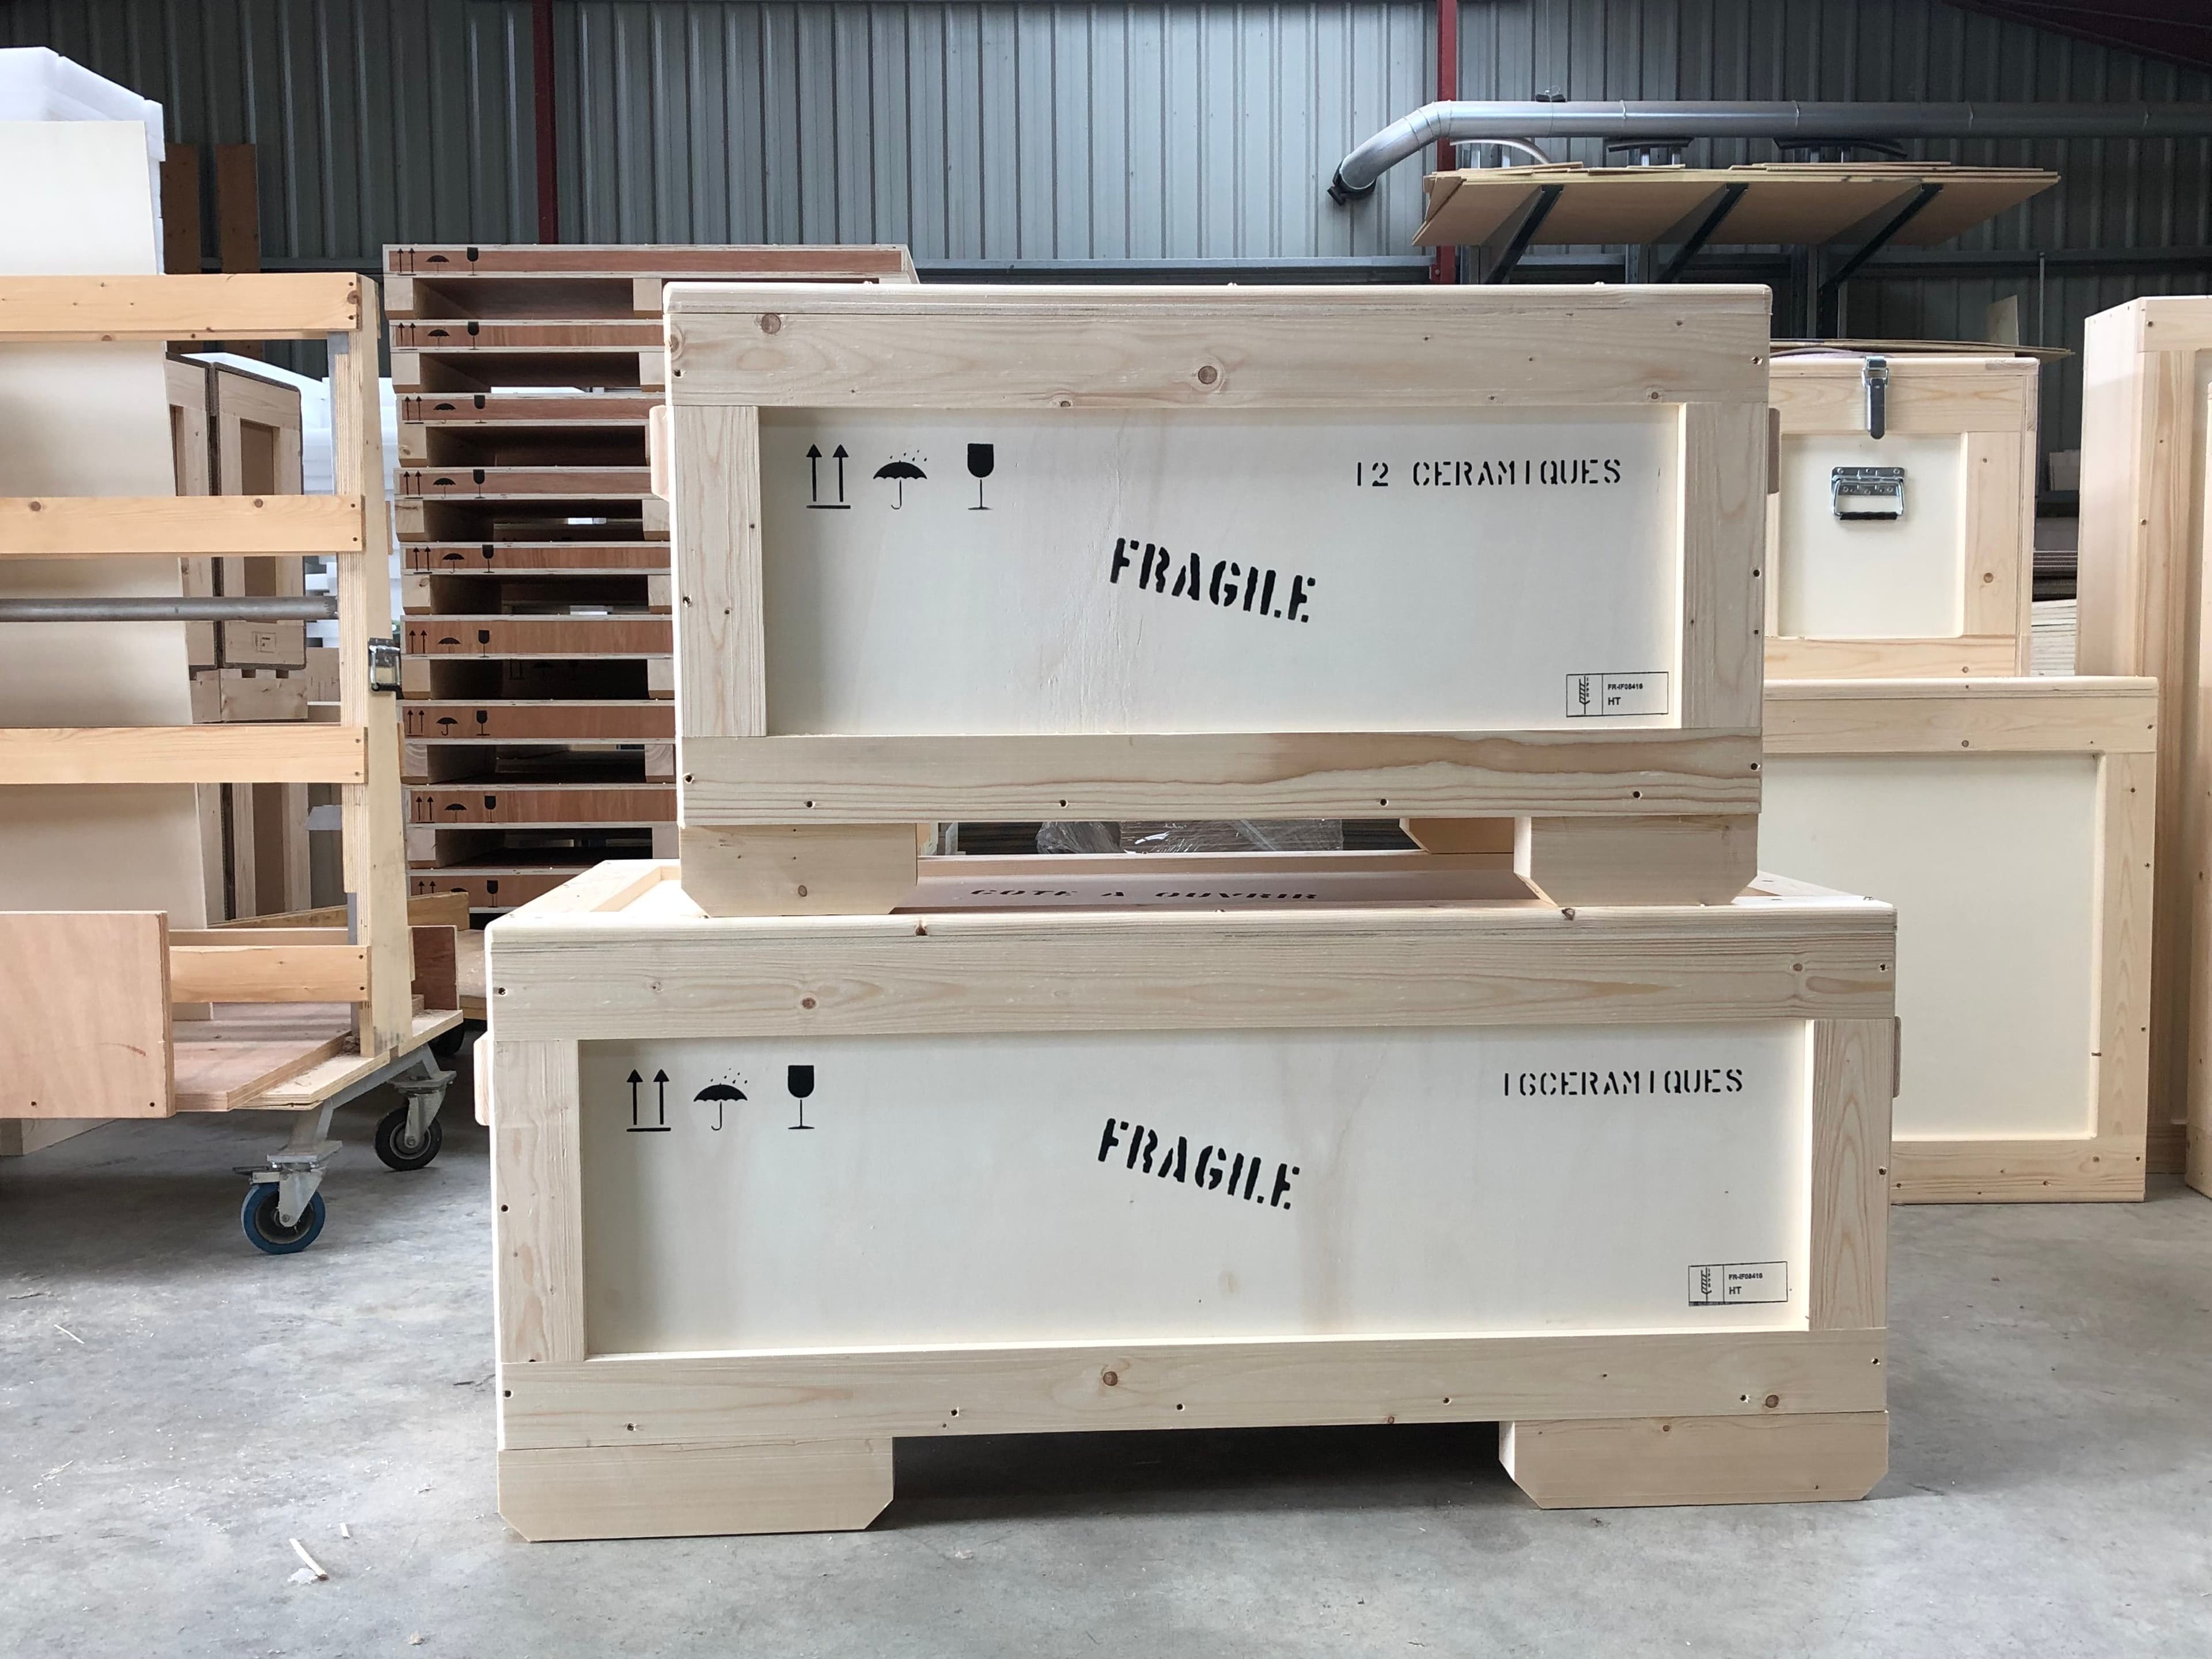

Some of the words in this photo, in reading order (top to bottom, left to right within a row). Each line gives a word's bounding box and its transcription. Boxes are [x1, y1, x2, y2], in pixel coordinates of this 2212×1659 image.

[1357, 461, 1389, 487] 12
[1412, 459, 1622, 487] CERAMIQUES
[1109, 537, 1316, 624] FRAGILE
[1608, 696, 1622, 706] HT
[1097, 1117, 1301, 1210] FRAGILE
[1728, 1286, 1742, 1295] HT
